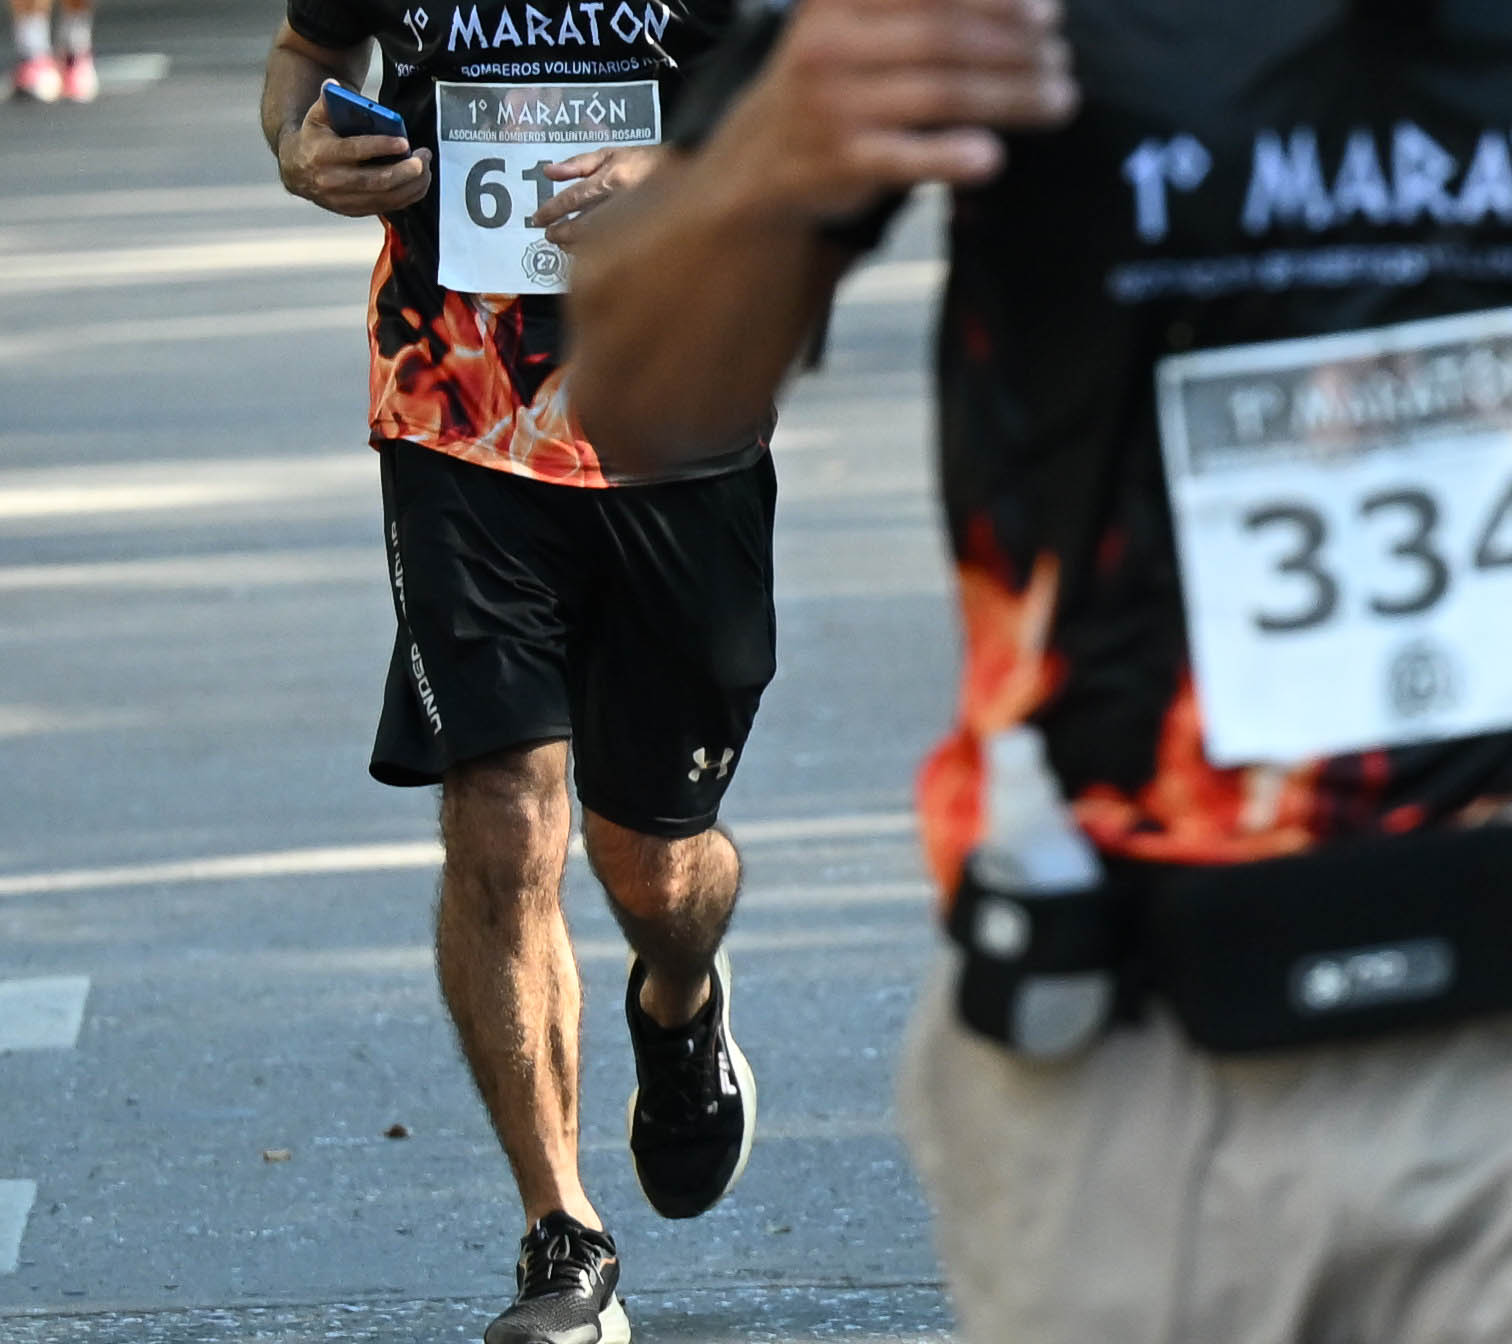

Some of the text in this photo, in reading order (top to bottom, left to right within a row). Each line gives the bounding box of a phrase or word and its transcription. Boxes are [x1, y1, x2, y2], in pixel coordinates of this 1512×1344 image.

[544, 57, 640, 75] VOLUNTARIOS
[497, 91, 627, 126] MARATÓN
[448, 127, 651, 142] ASOCIACIÓN BOMBEROS VOLUNTARIOS ROSARIO
